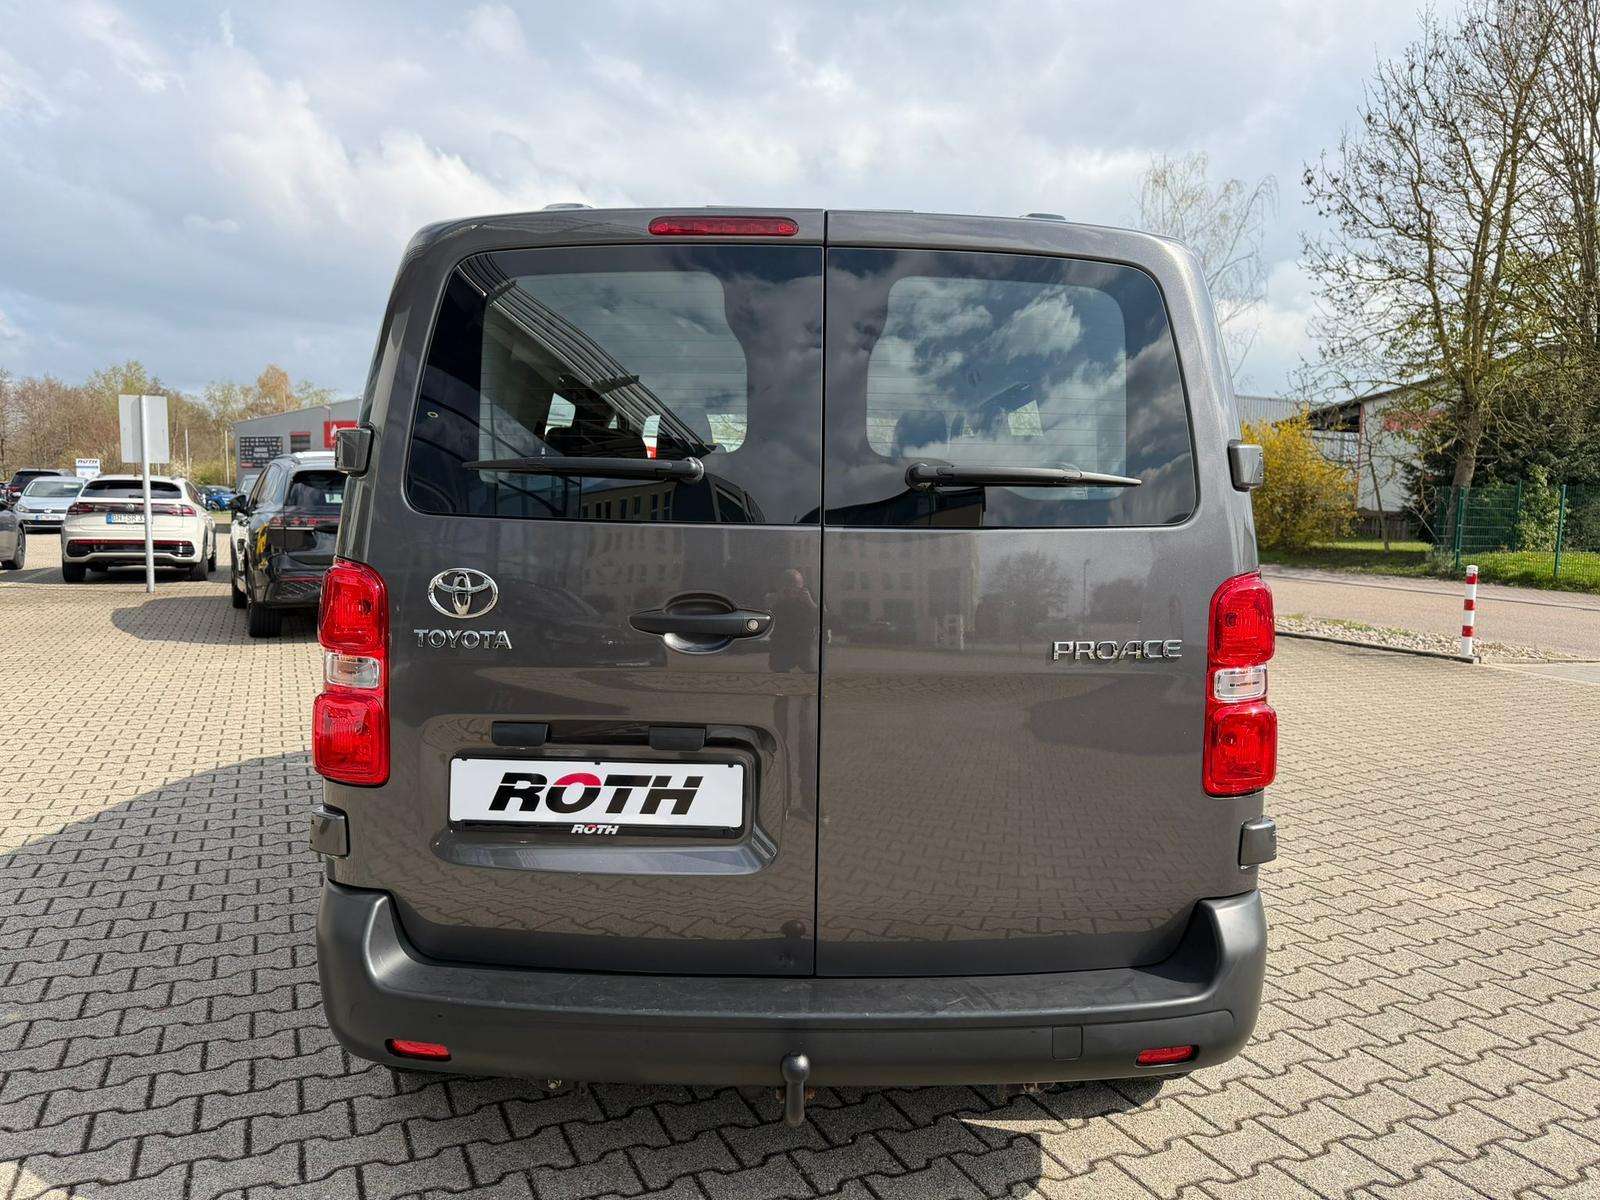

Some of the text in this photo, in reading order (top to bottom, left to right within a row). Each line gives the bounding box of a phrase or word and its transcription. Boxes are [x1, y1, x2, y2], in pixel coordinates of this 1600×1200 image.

[413, 628, 513, 650] TOYOTA
[1053, 639, 1183, 661] PROACE
[488, 772, 704, 815] ROTH
[570, 823, 620, 836] ROTH
